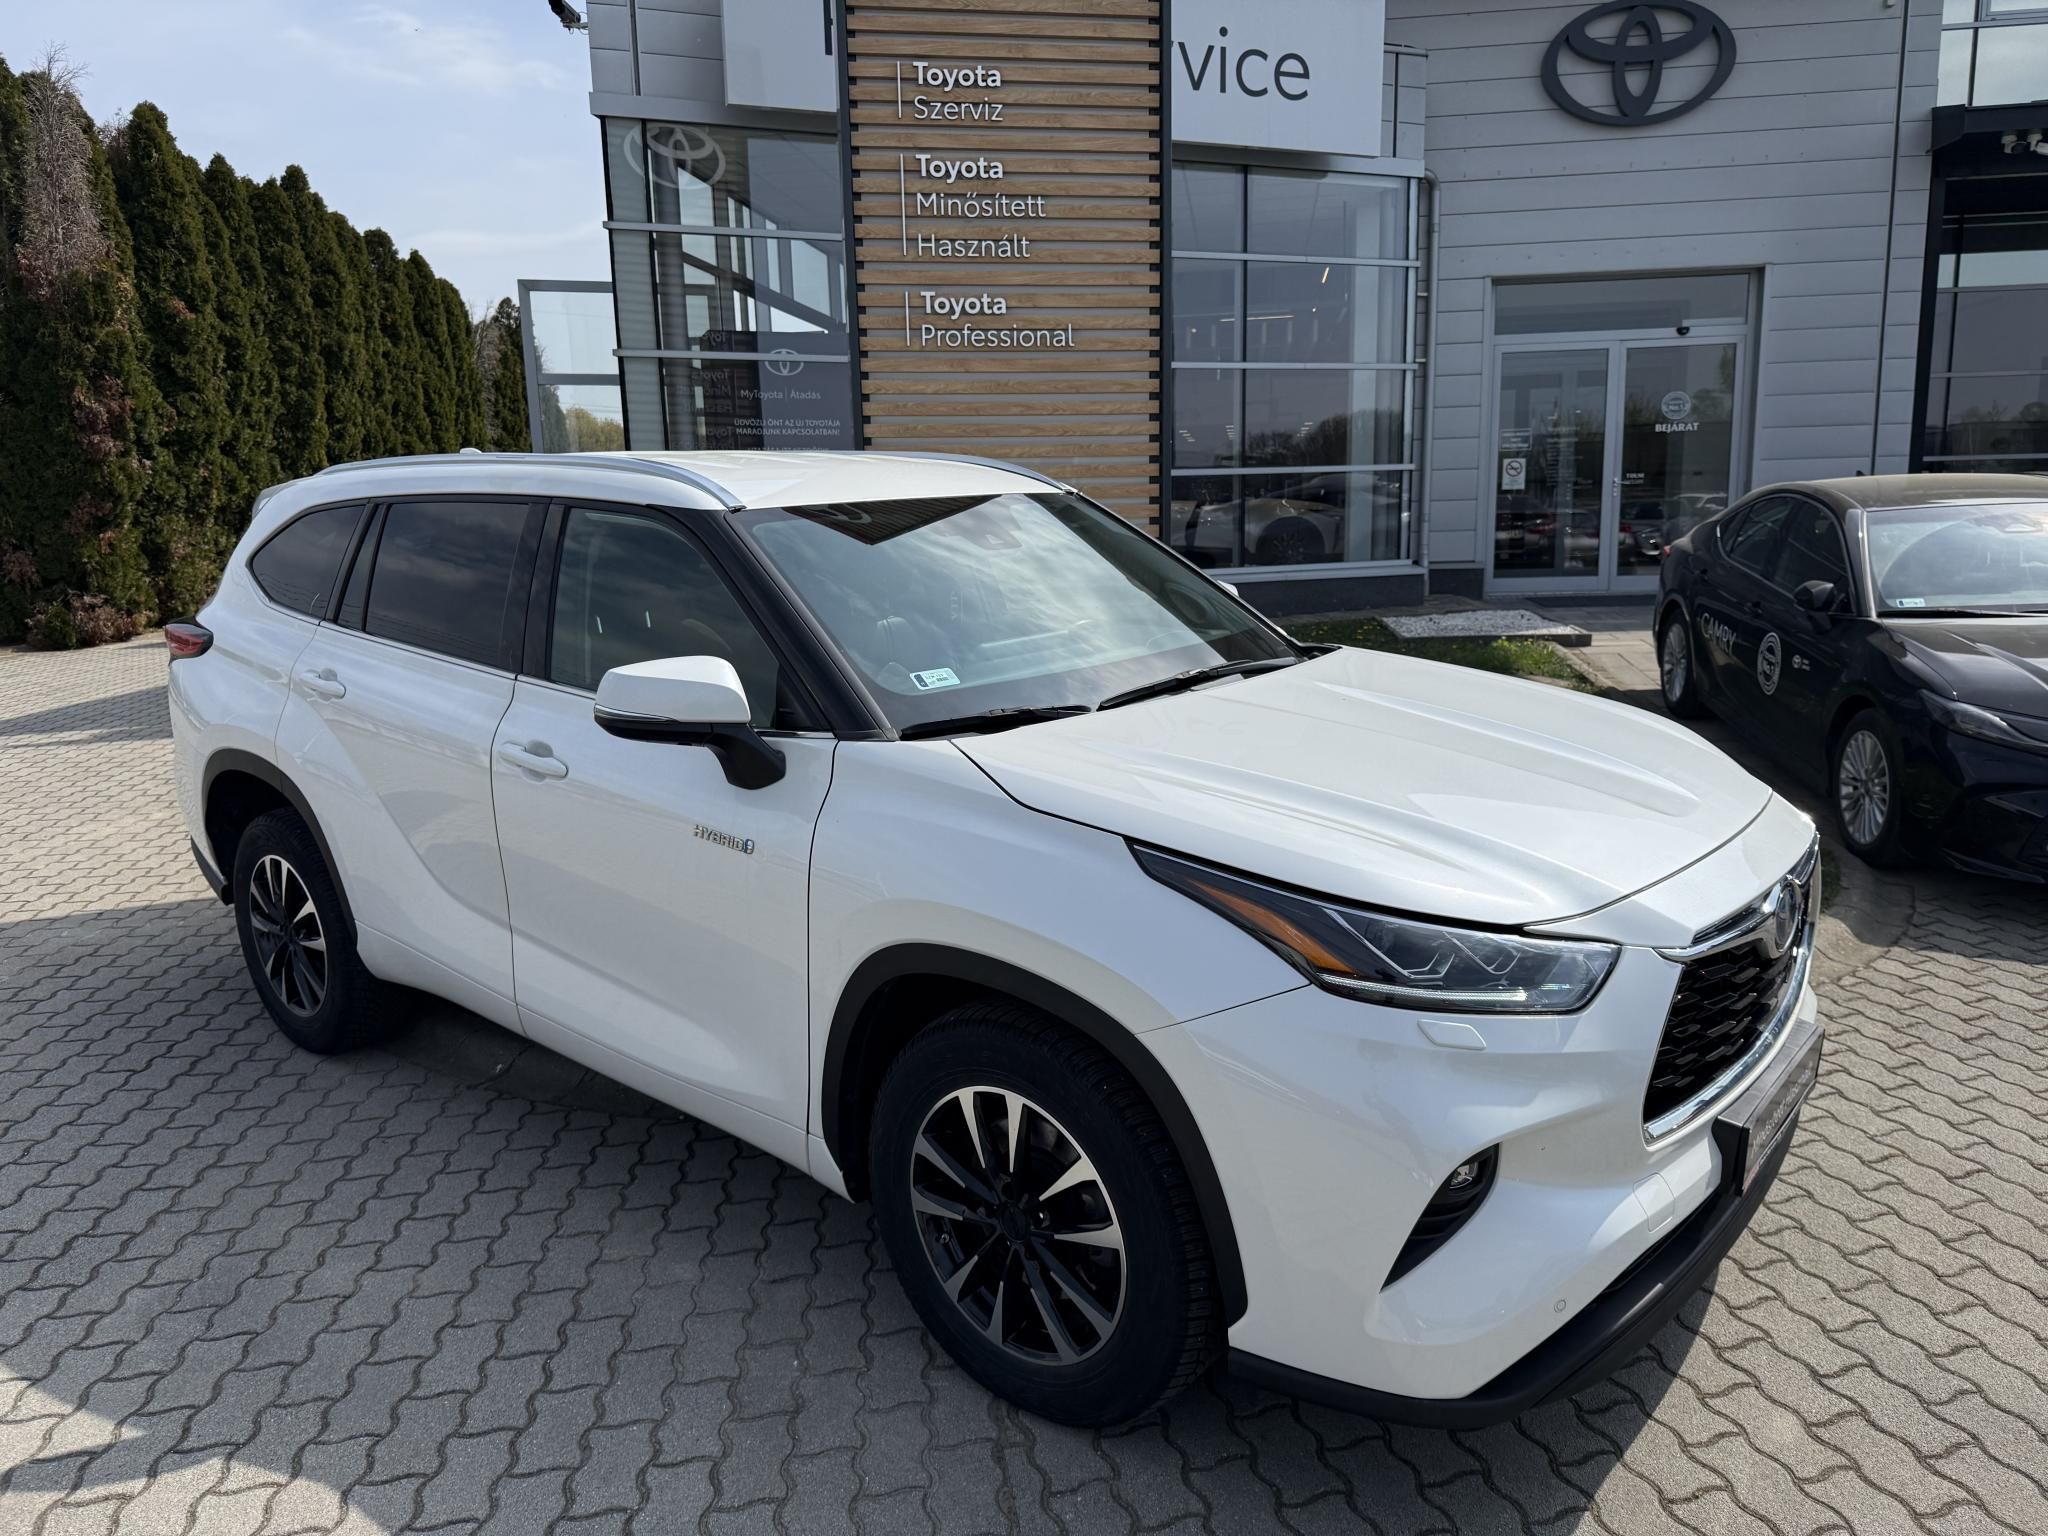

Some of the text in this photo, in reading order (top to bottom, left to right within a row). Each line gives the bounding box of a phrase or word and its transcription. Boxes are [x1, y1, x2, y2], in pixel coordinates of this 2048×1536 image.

[912, 61, 1002, 92] Toyota
[1171, 26, 1310, 101] vice
[914, 95, 1004, 121] Szerviz
[915, 154, 1004, 184] Toyota
[916, 191, 1047, 218] Minősített
[918, 233, 1031, 258] Használt
[920, 291, 1007, 320] Toyota
[921, 323, 1075, 347] Professional
[740, 389, 783, 401] MyToyota
[1655, 420, 1700, 433] BEJÁRAT
[1701, 612, 1737, 657] CAMRY
[693, 823, 745, 852] HYBRID
